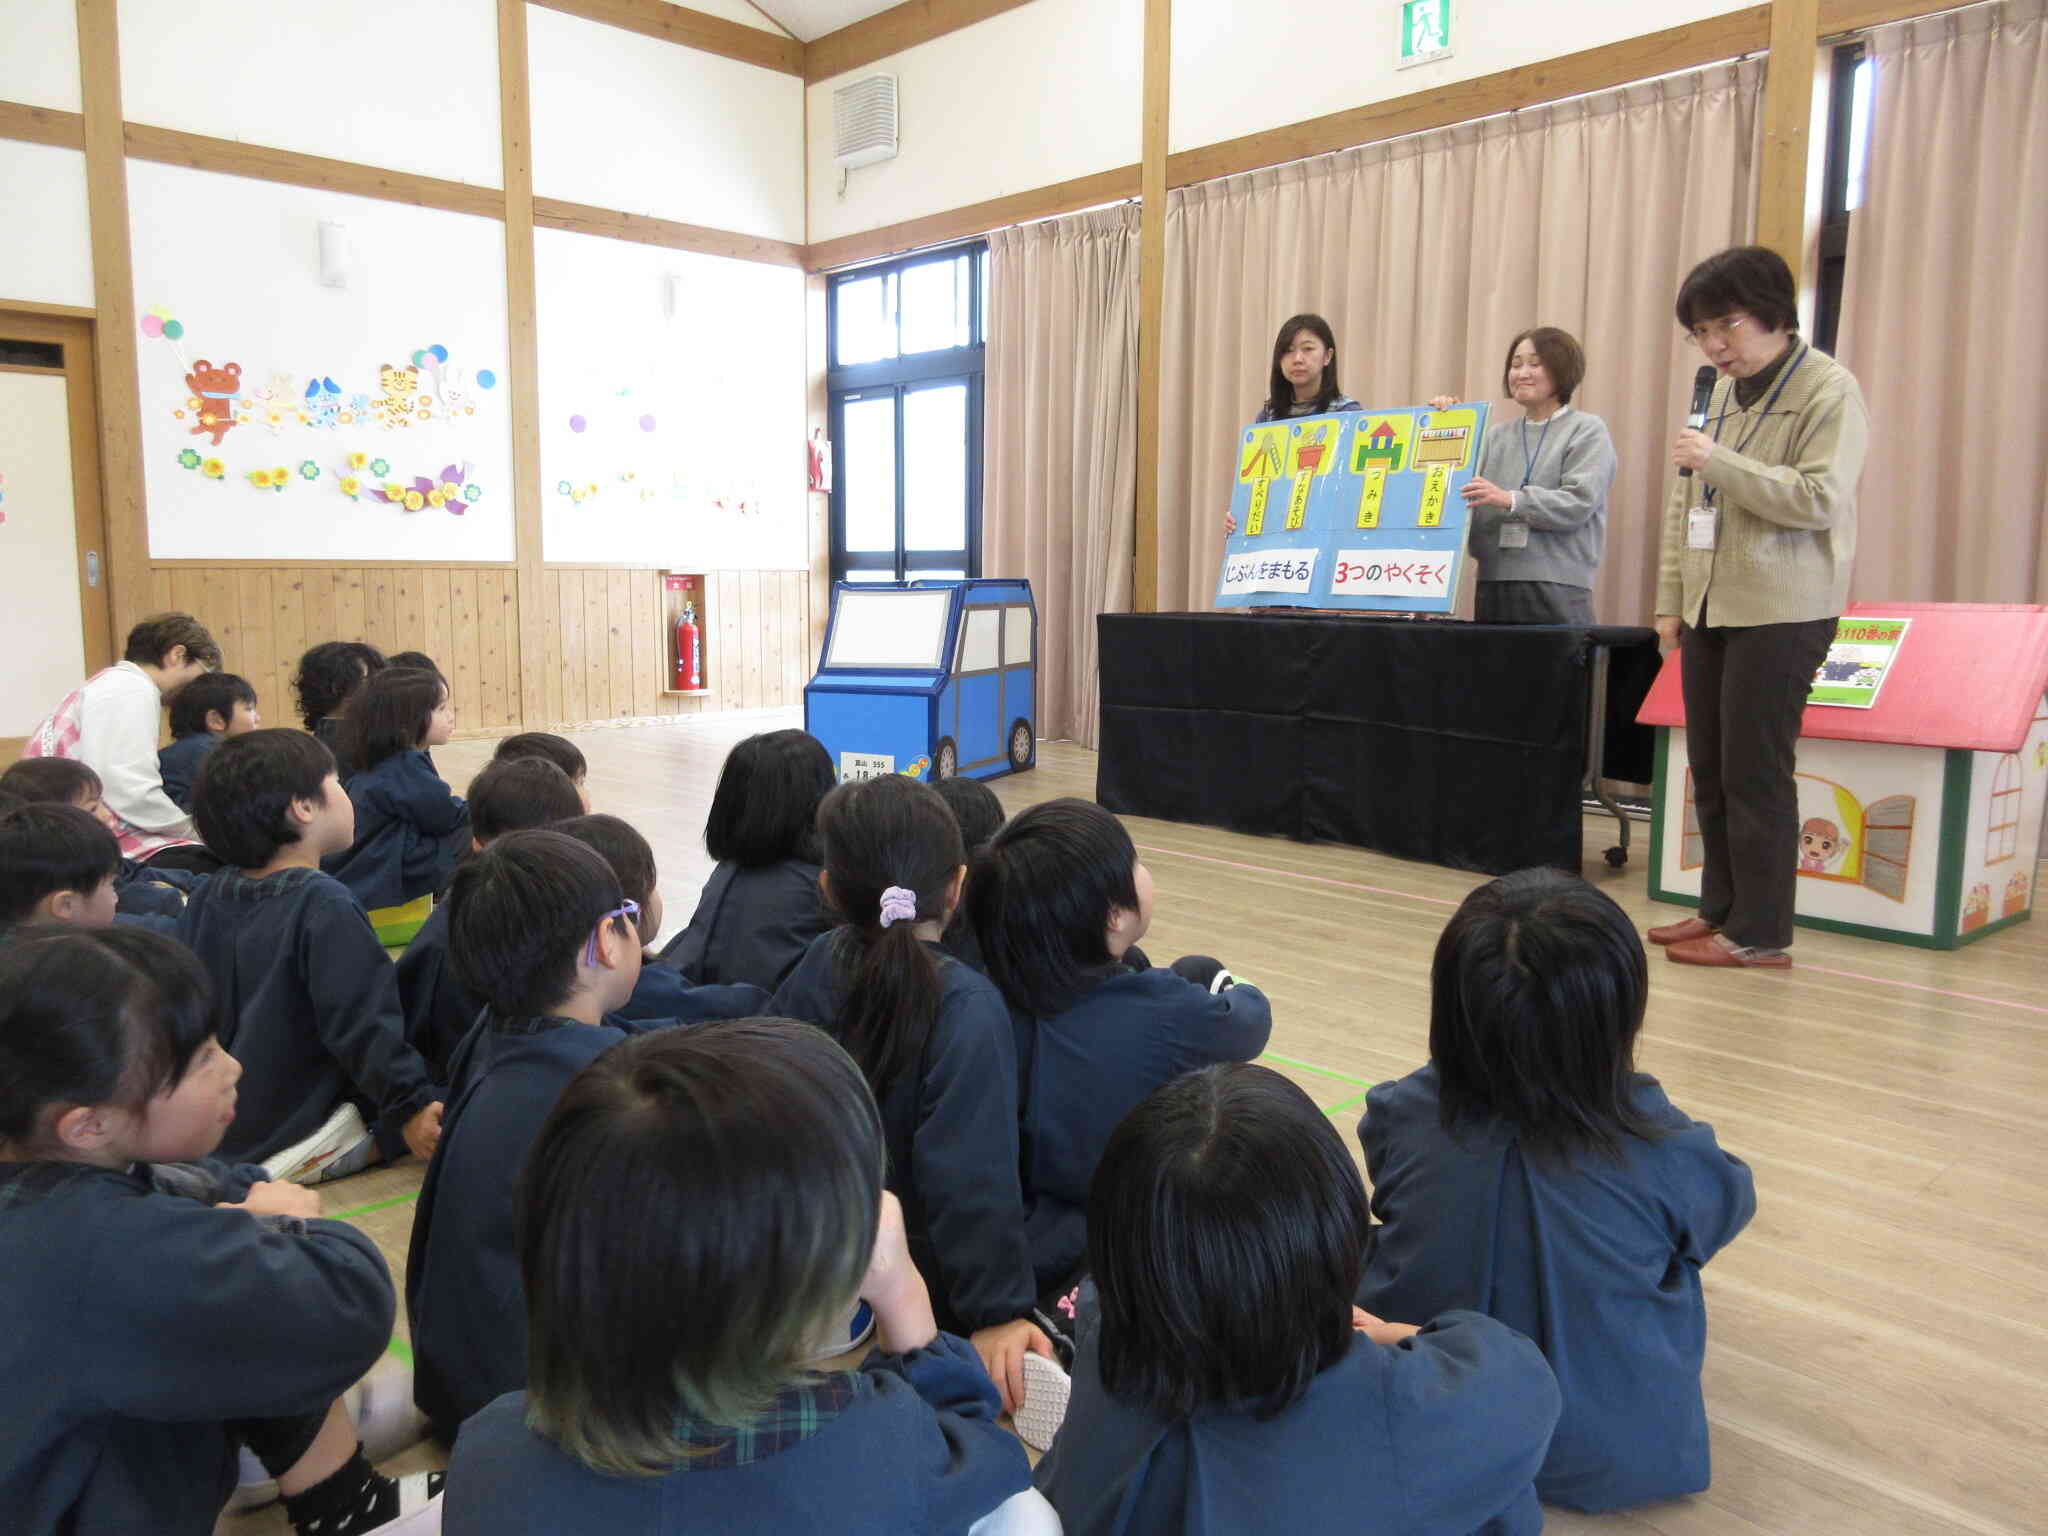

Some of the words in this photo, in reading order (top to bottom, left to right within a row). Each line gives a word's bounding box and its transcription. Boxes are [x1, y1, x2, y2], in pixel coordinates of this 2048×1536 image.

[1363, 471, 1381, 523] つみき
[1425, 467, 1445, 524] おえかき
[1225, 560, 1309, 583] じぶんをまもる
[1335, 561, 1447, 584] 3つのやくそく
